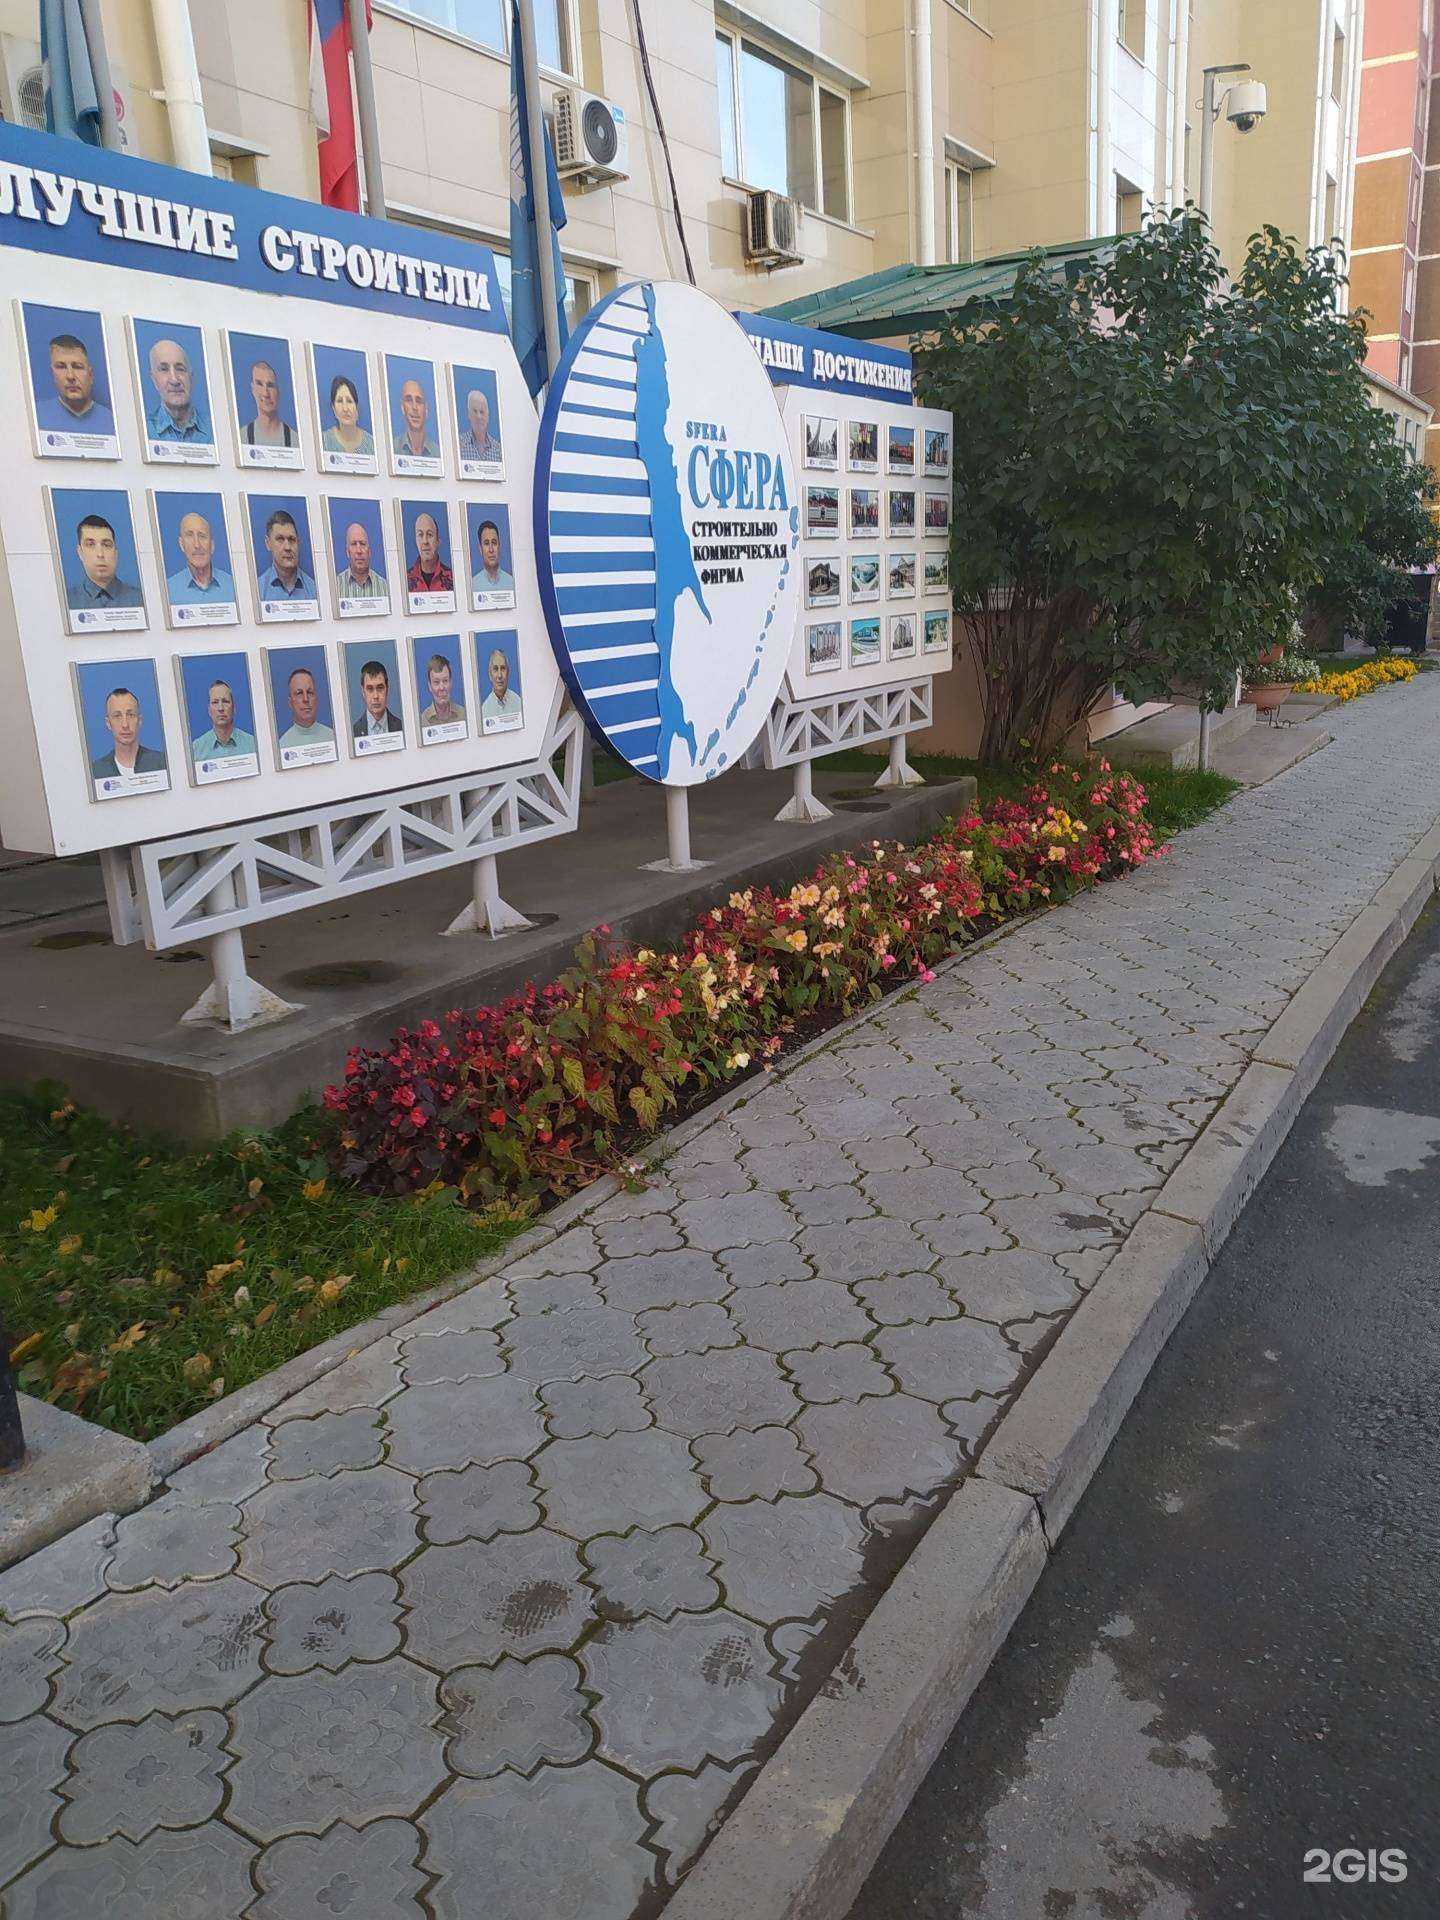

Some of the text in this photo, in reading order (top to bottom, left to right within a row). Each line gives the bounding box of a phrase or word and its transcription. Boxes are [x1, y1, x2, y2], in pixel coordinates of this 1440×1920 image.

[0, 160, 491, 312] ЛУЧШИЕ СТРОИТЕЛИ
[811, 349, 912, 393] ДОСТИЖЕНИЯ
[686, 421, 727, 442] SFERA
[688, 444, 789, 511] СФЕРА
[692, 520, 778, 537] СТРОИТЕЛЬНО
[693, 544, 787, 562] КОММЕРЧЕСКАЯ
[701, 566, 744, 584] ФИРМА
